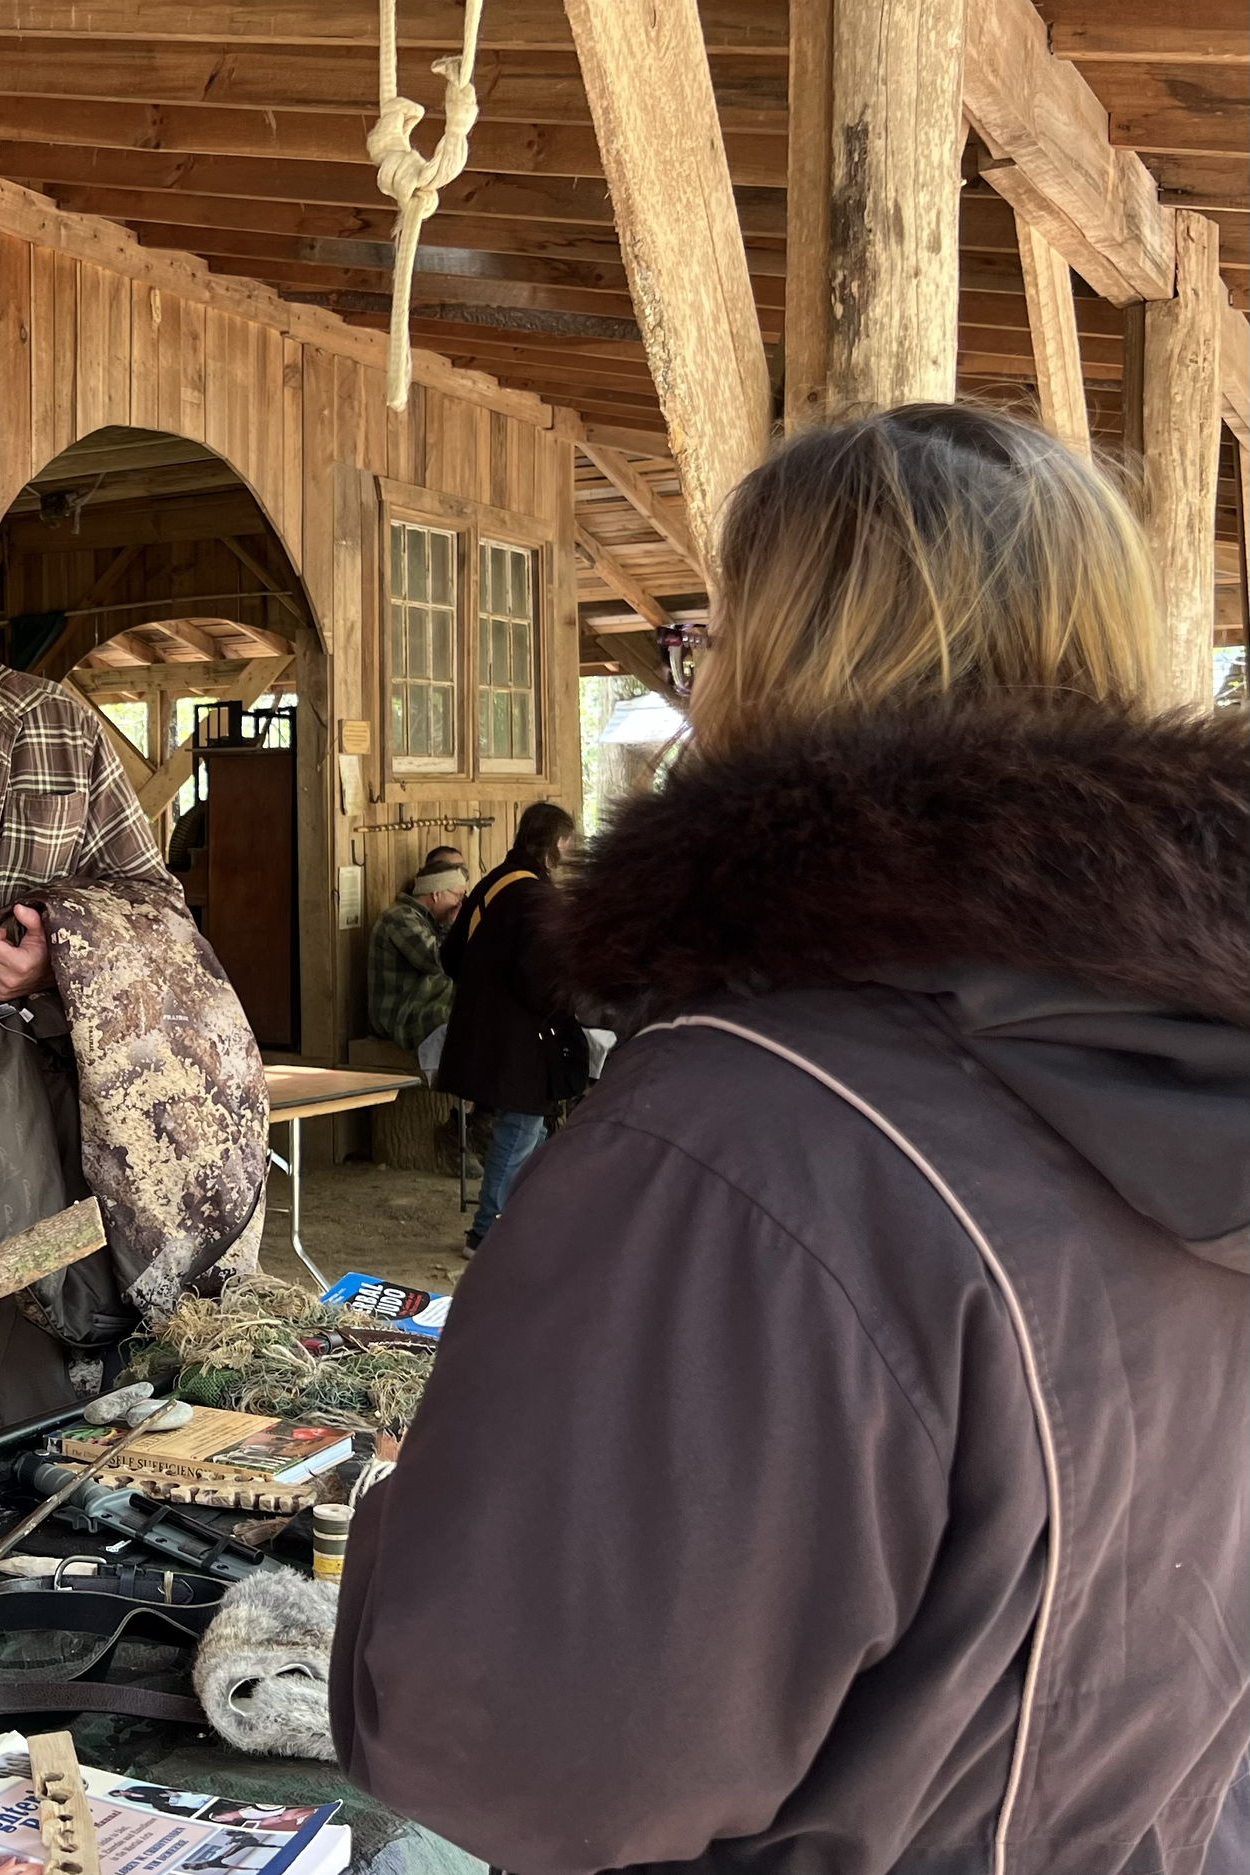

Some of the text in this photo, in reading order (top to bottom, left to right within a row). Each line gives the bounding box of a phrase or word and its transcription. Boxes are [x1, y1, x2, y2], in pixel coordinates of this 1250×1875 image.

[351, 1282, 384, 1315] ERBAL
[375, 1288, 406, 1317] JUDO
[110, 1455, 135, 1467] SELF
[138, 1459, 208, 1479] SUFFICIENC
